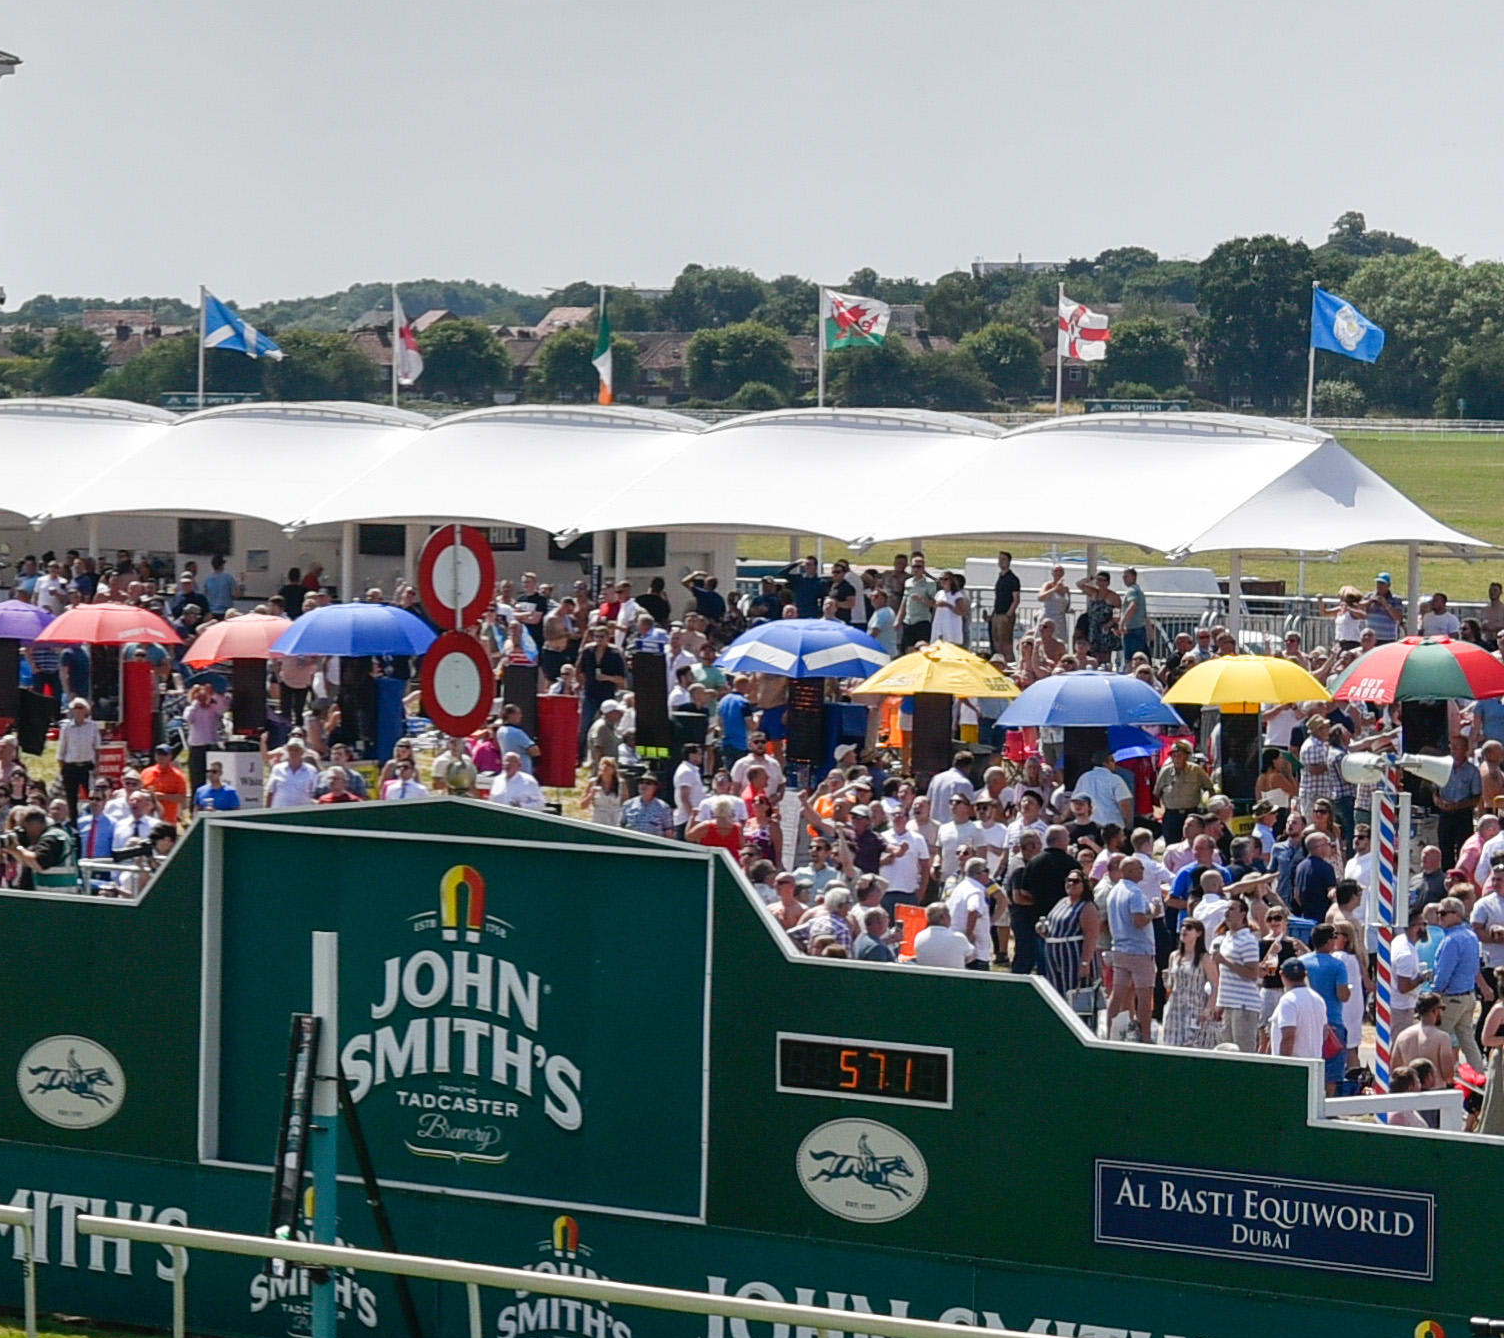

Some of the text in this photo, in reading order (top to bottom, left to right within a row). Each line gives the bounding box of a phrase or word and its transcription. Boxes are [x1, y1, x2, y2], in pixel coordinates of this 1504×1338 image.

[490, 527, 519, 544] HILL
[1348, 686, 1386, 700] FABER
[1360, 677, 1384, 689] GUY
[370, 949, 540, 1032] JOHN
[340, 1017, 583, 1131] SMITH'S
[839, 1049, 913, 1093] 57.1
[396, 1090, 520, 1118] TADCASTER
[416, 1112, 501, 1151] Brewery
[1159, 1180, 1235, 1218] BASTI
[1242, 1189, 1415, 1237] EQUIWORLD
[1231, 1223, 1290, 1250] DUBAI
[250, 1267, 377, 1328] SMIH'S
